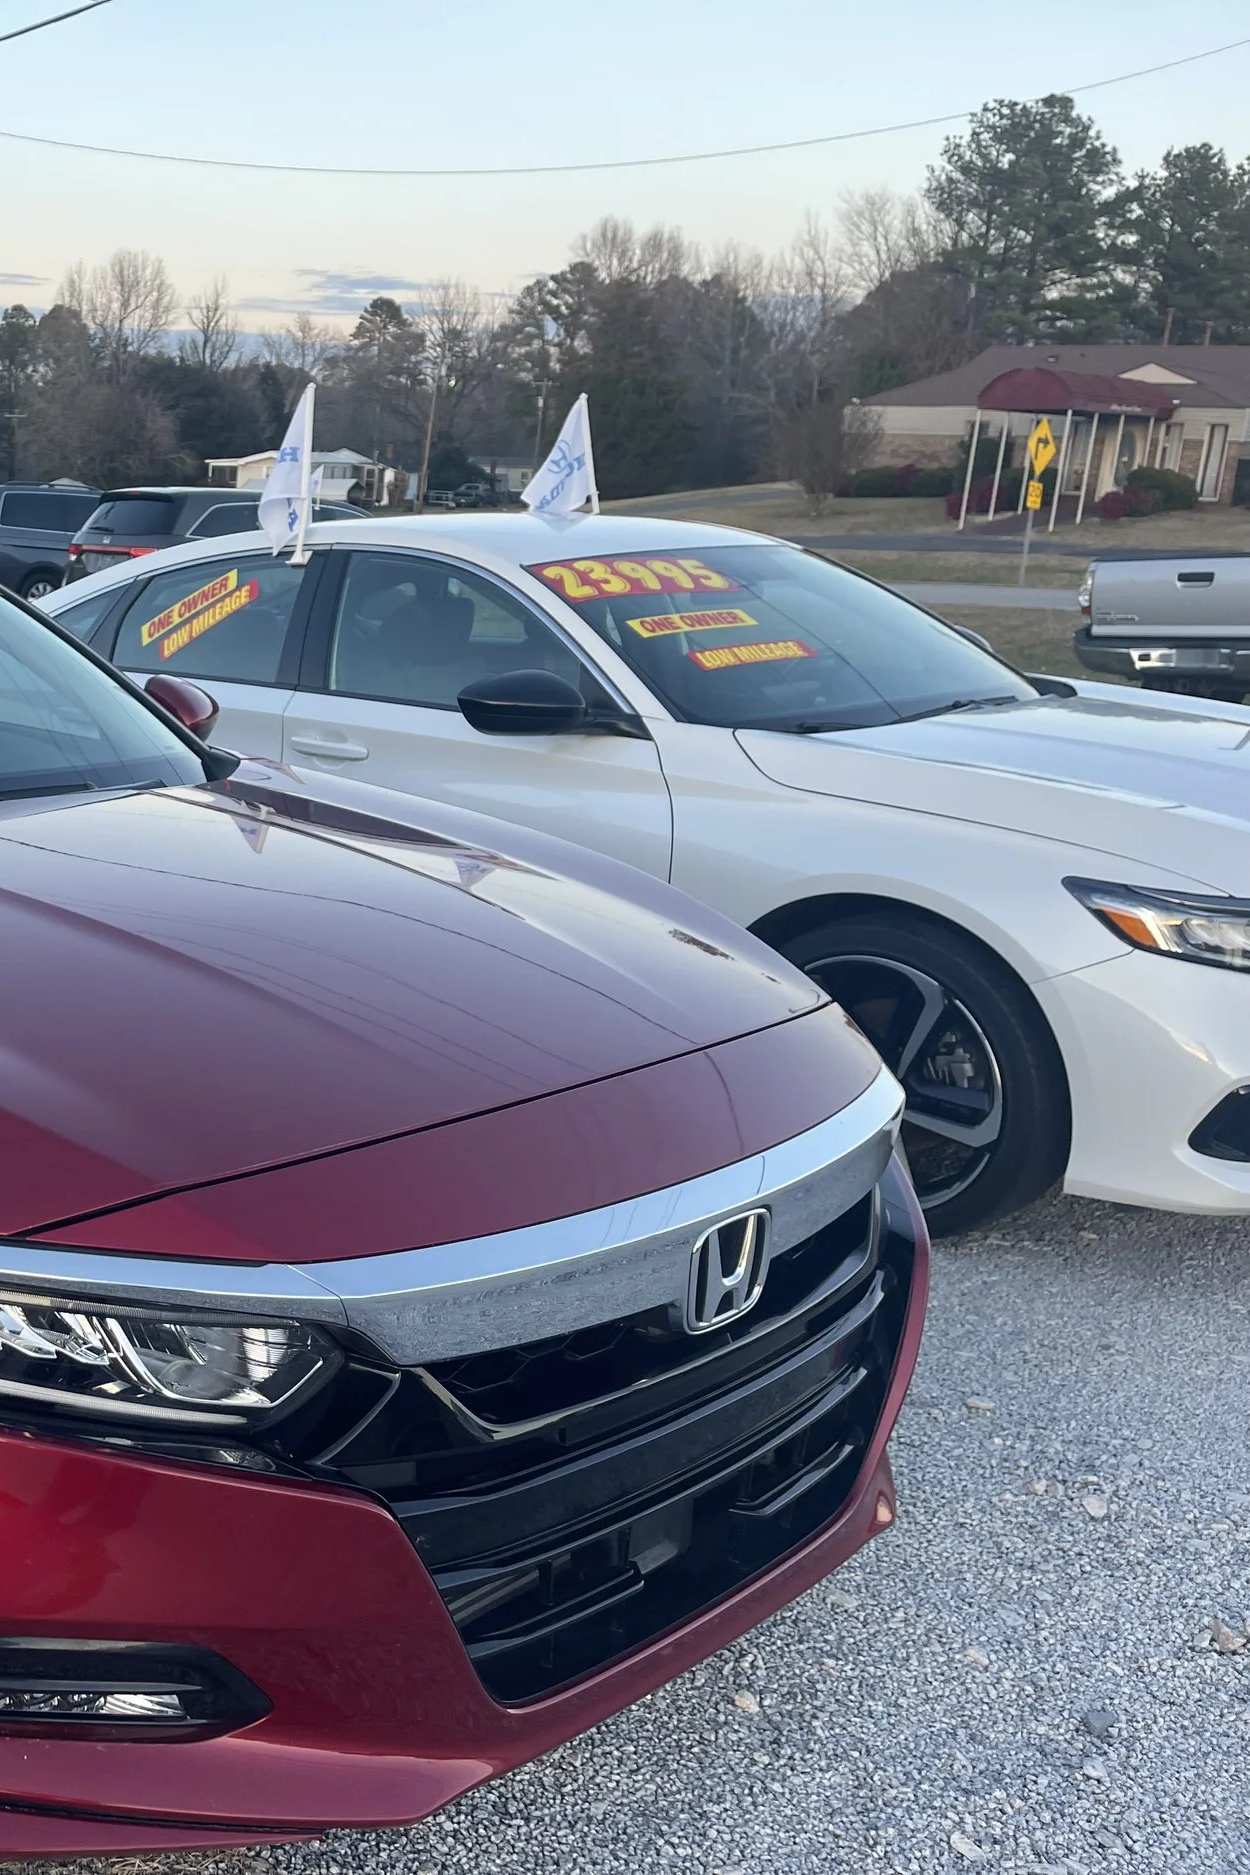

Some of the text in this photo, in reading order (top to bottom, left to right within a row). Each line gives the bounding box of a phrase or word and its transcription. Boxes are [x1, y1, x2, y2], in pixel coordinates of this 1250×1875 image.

[542, 558, 731, 598] 23995
[148, 575, 229, 638] ONE OWNER
[164, 583, 251, 658] LOW MILEAGE
[639, 611, 746, 634] ONE OWNER
[696, 641, 808, 669] LOW MILEAGE
